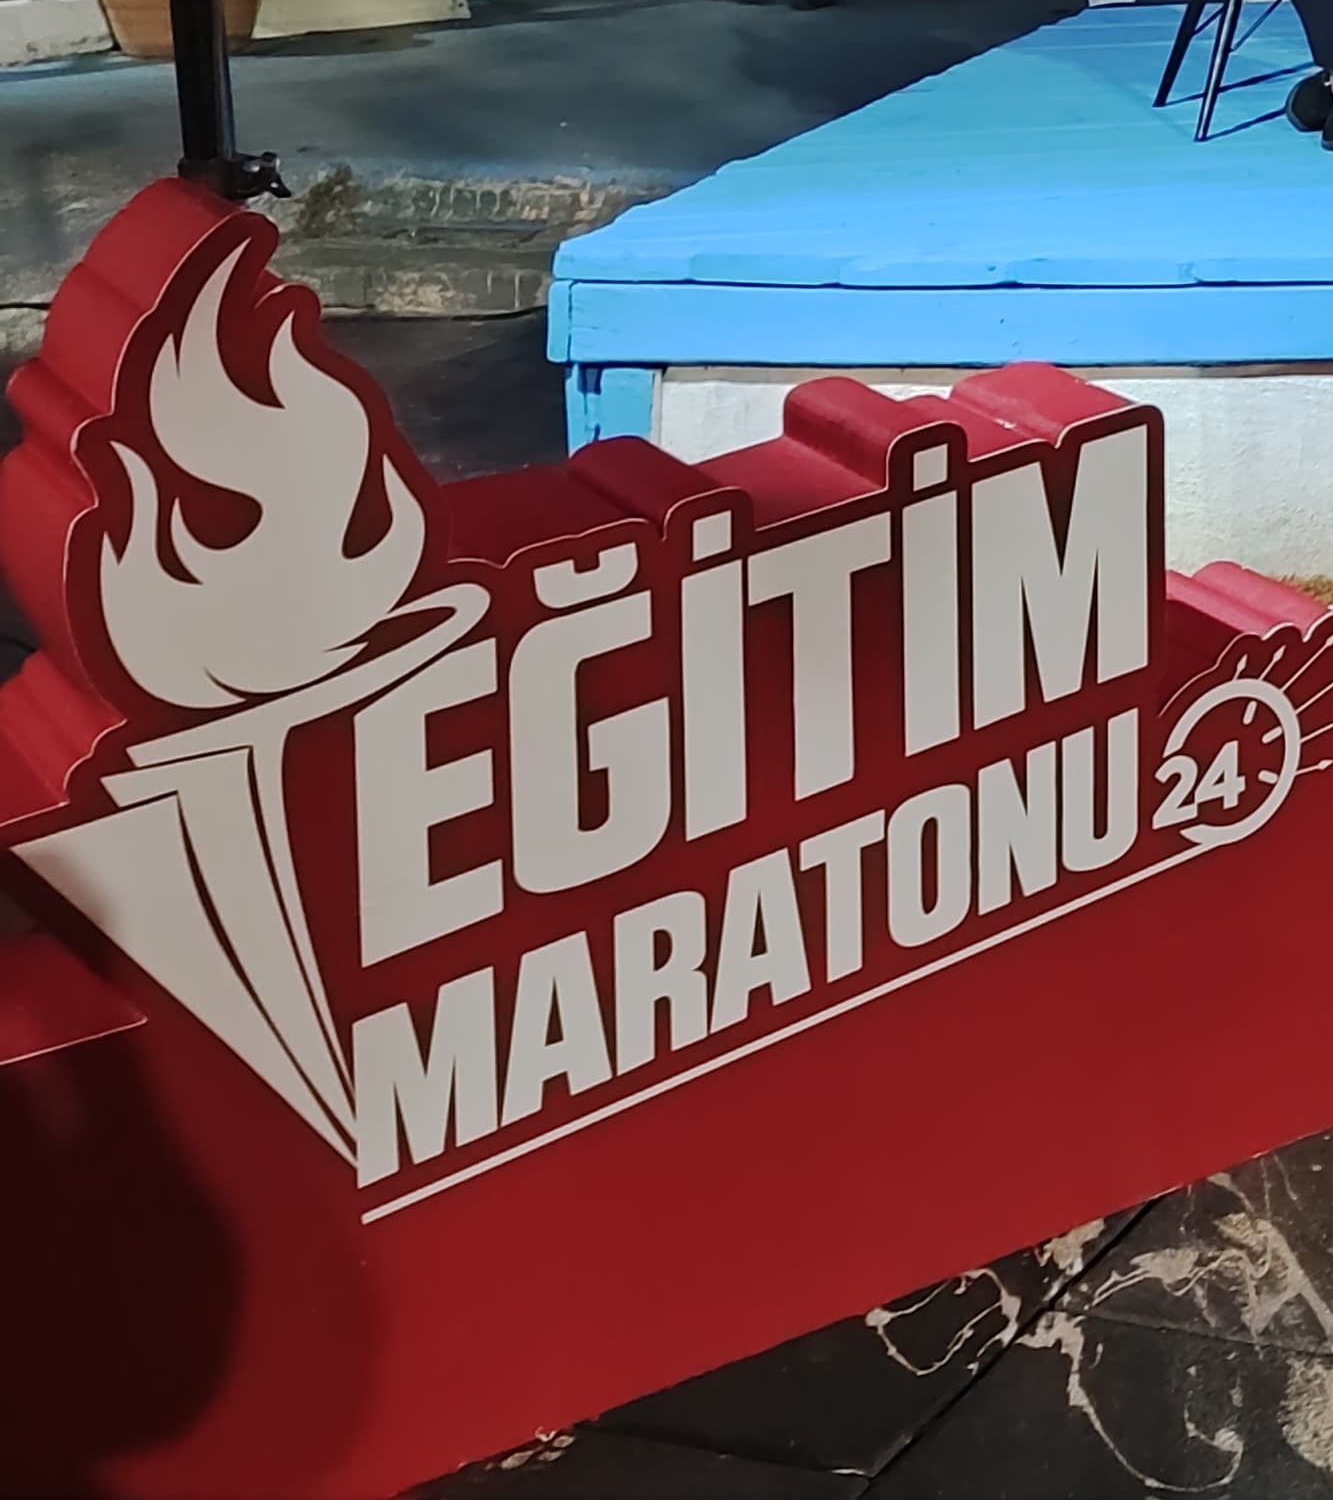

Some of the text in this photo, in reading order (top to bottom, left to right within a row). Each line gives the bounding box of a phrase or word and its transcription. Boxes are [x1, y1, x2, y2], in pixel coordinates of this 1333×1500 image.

[351, 707, 1247, 1188] MARATONU 24
[352, 422, 1151, 971] EĞİTİM
